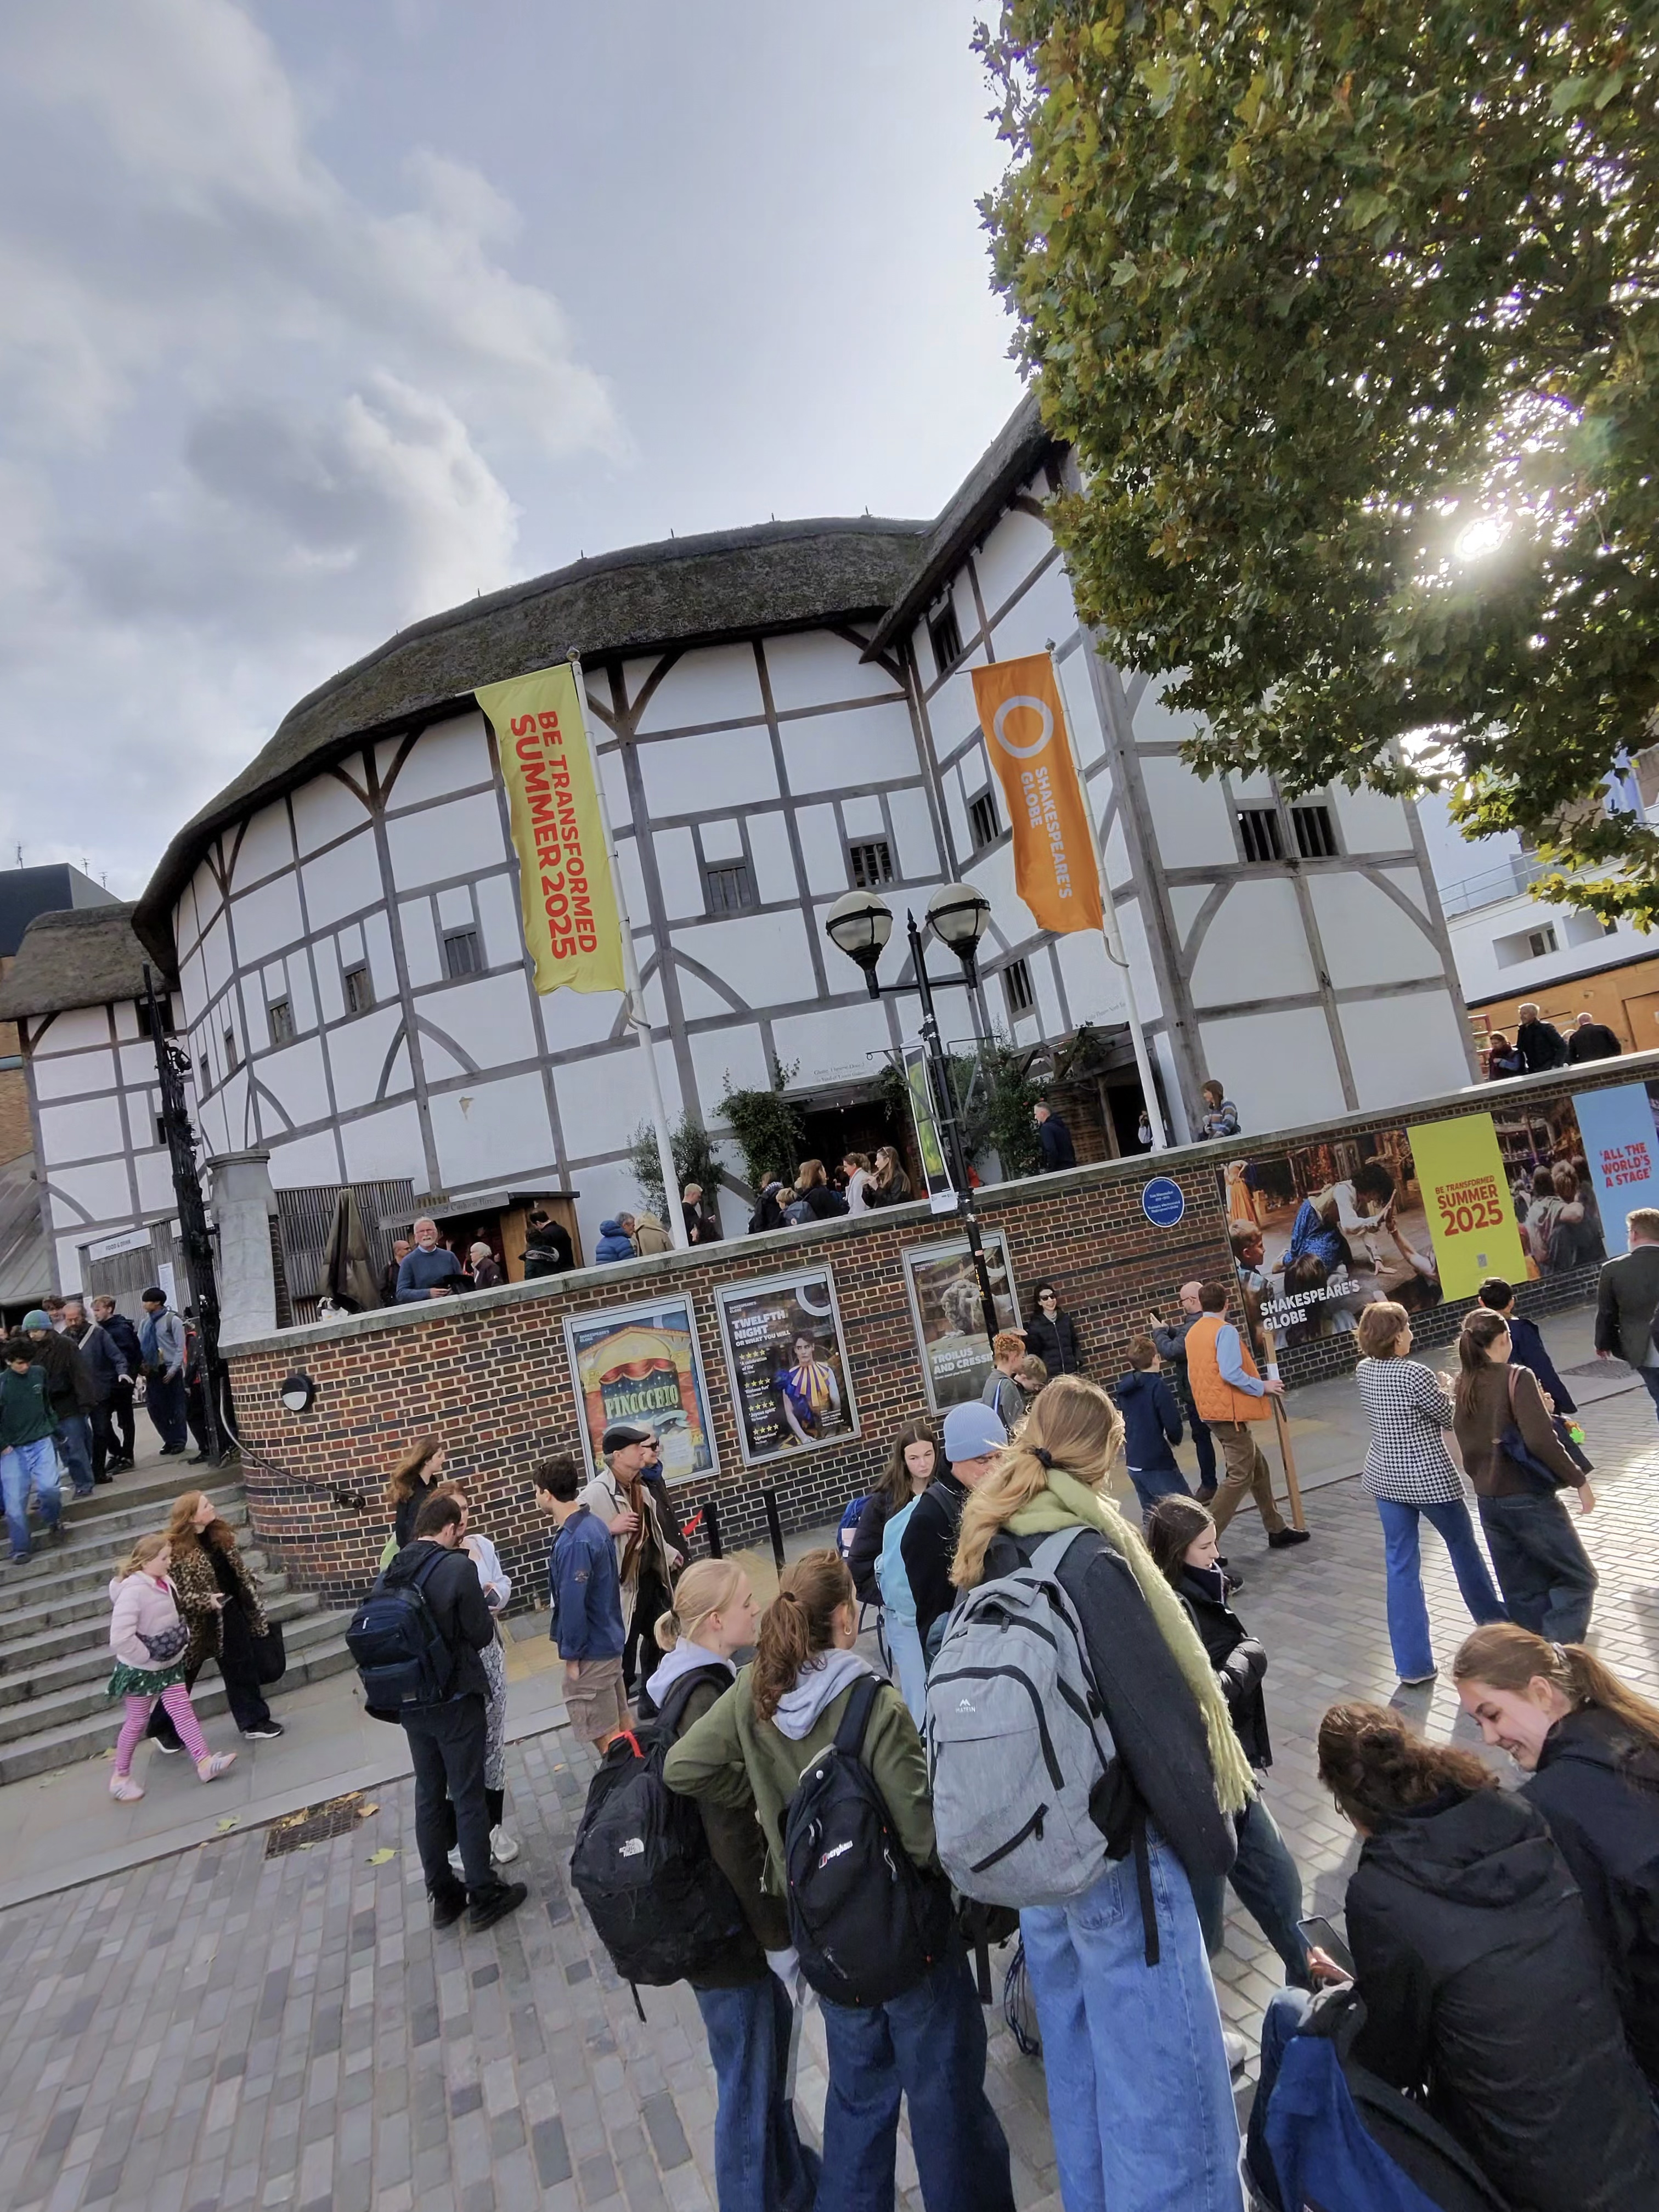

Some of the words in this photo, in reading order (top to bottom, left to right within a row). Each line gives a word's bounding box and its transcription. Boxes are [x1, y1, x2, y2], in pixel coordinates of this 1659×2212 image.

[538, 711, 562, 747] BE
[1021, 771, 1043, 828] GLOBE
[511, 714, 561, 869] SUMMER
[541, 871, 577, 959] 2025
[1035, 766, 1073, 899] SHAKESPEARE'S
[549, 754, 597, 952] TRANSFORMED
[1600, 1148, 1624, 1161] 'ALL
[1624, 1142, 1647, 1156] THE
[1601, 1155, 1651, 1175] WORLD'S
[1446, 1175, 1495, 1192] TRANSFORMED
[1606, 1177, 1614, 1188] A
[1616, 1166, 1652, 1186] STAGE'
[1437, 1184, 1498, 1210] SUMMER
[1440, 1199, 1503, 1237] 2025
[1260, 1279, 1361, 1316] SHAKESPEARE'S
[731, 1310, 786, 1329] TWELFTH
[1263, 1308, 1307, 1331] GLOBE
[734, 1324, 768, 1340] NIGHT
[745, 1336, 763, 1345] WHAT
[764, 1332, 776, 1340] YOU
[932, 1347, 974, 1364] TROILUS
[933, 1362, 955, 1375] AND
[956, 1353, 994, 1369] CRESSI
[604, 1384, 679, 1420] PINOCCHIO
